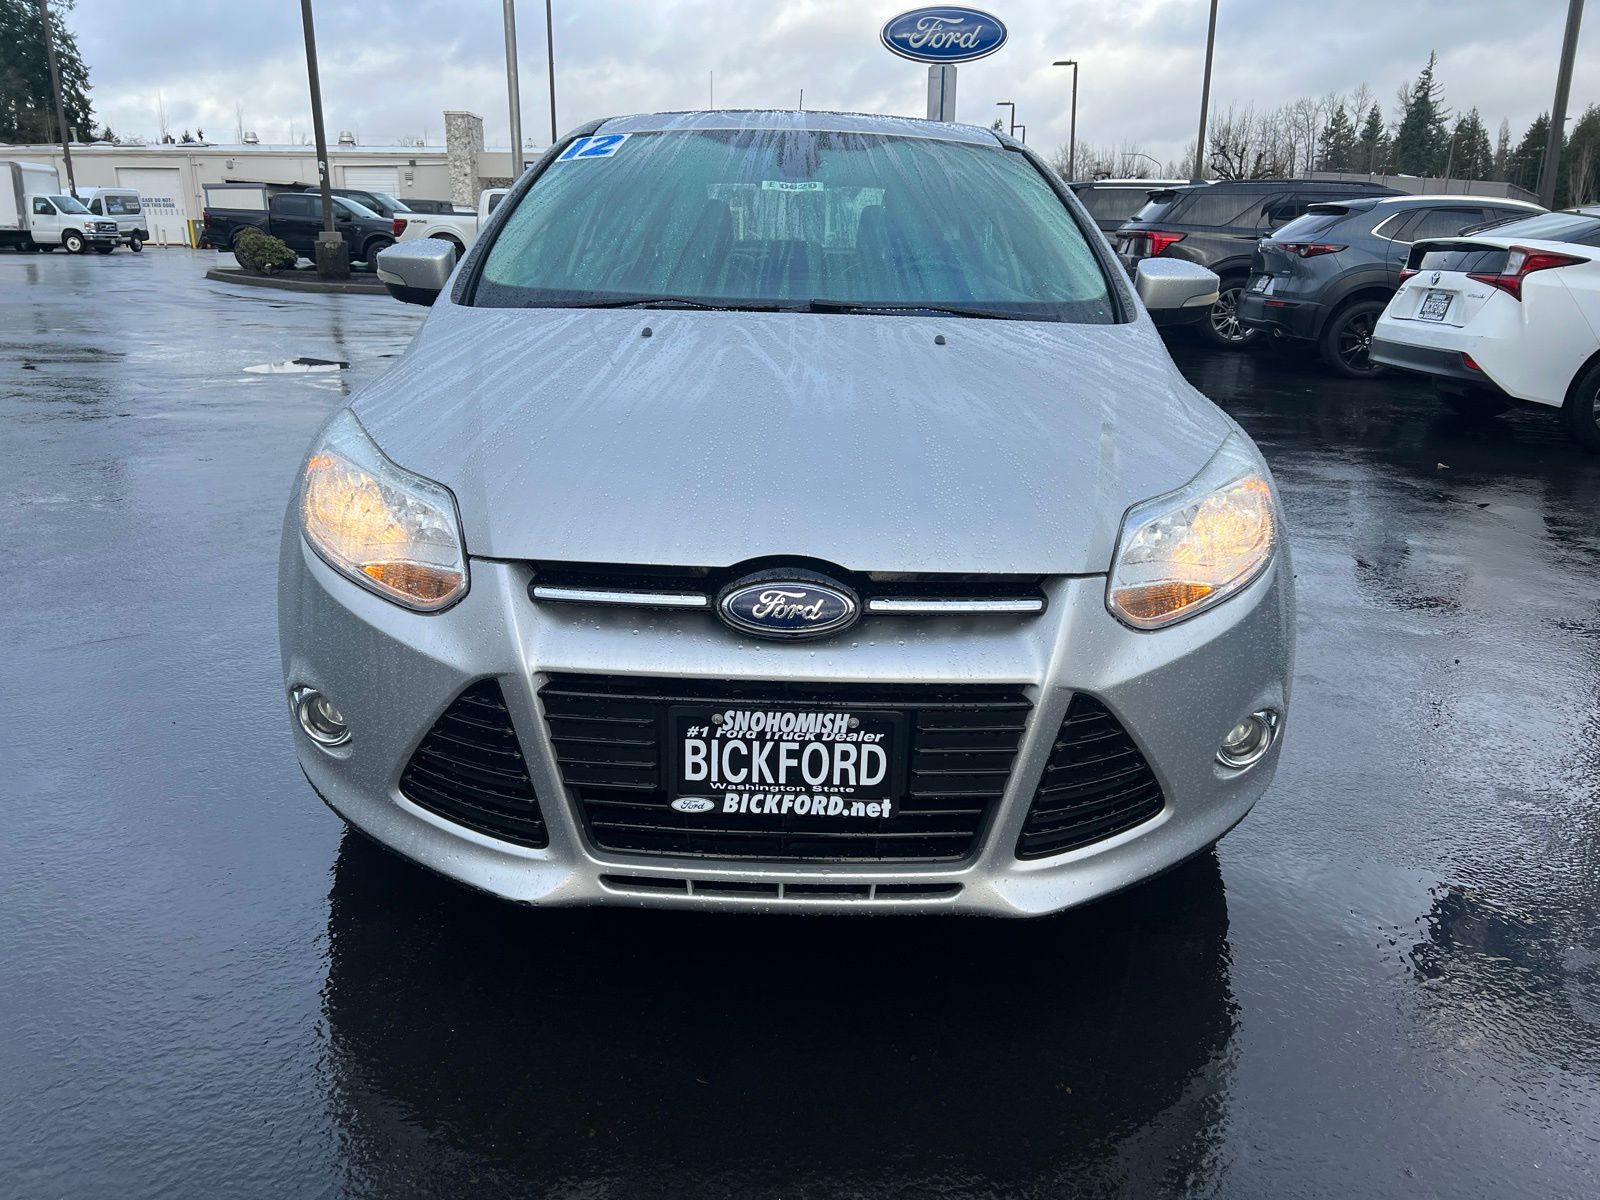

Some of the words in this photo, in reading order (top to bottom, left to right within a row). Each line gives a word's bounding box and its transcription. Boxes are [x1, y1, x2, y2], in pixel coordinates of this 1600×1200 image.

[908, 16, 982, 49] Ford
[560, 134, 625, 160] 12
[752, 590, 824, 620] Ford
[686, 726, 709, 738] #1
[715, 726, 757, 739] Ford
[765, 730, 817, 741] Truck
[821, 730, 885, 742] Dealer
[722, 710, 850, 734] SNOHOMISH
[684, 739, 888, 786] BICKFORD
[710, 782, 806, 793] Washington
[812, 785, 855, 793] State
[680, 800, 706, 810] Ford
[722, 792, 892, 818] BICKFORD.net
